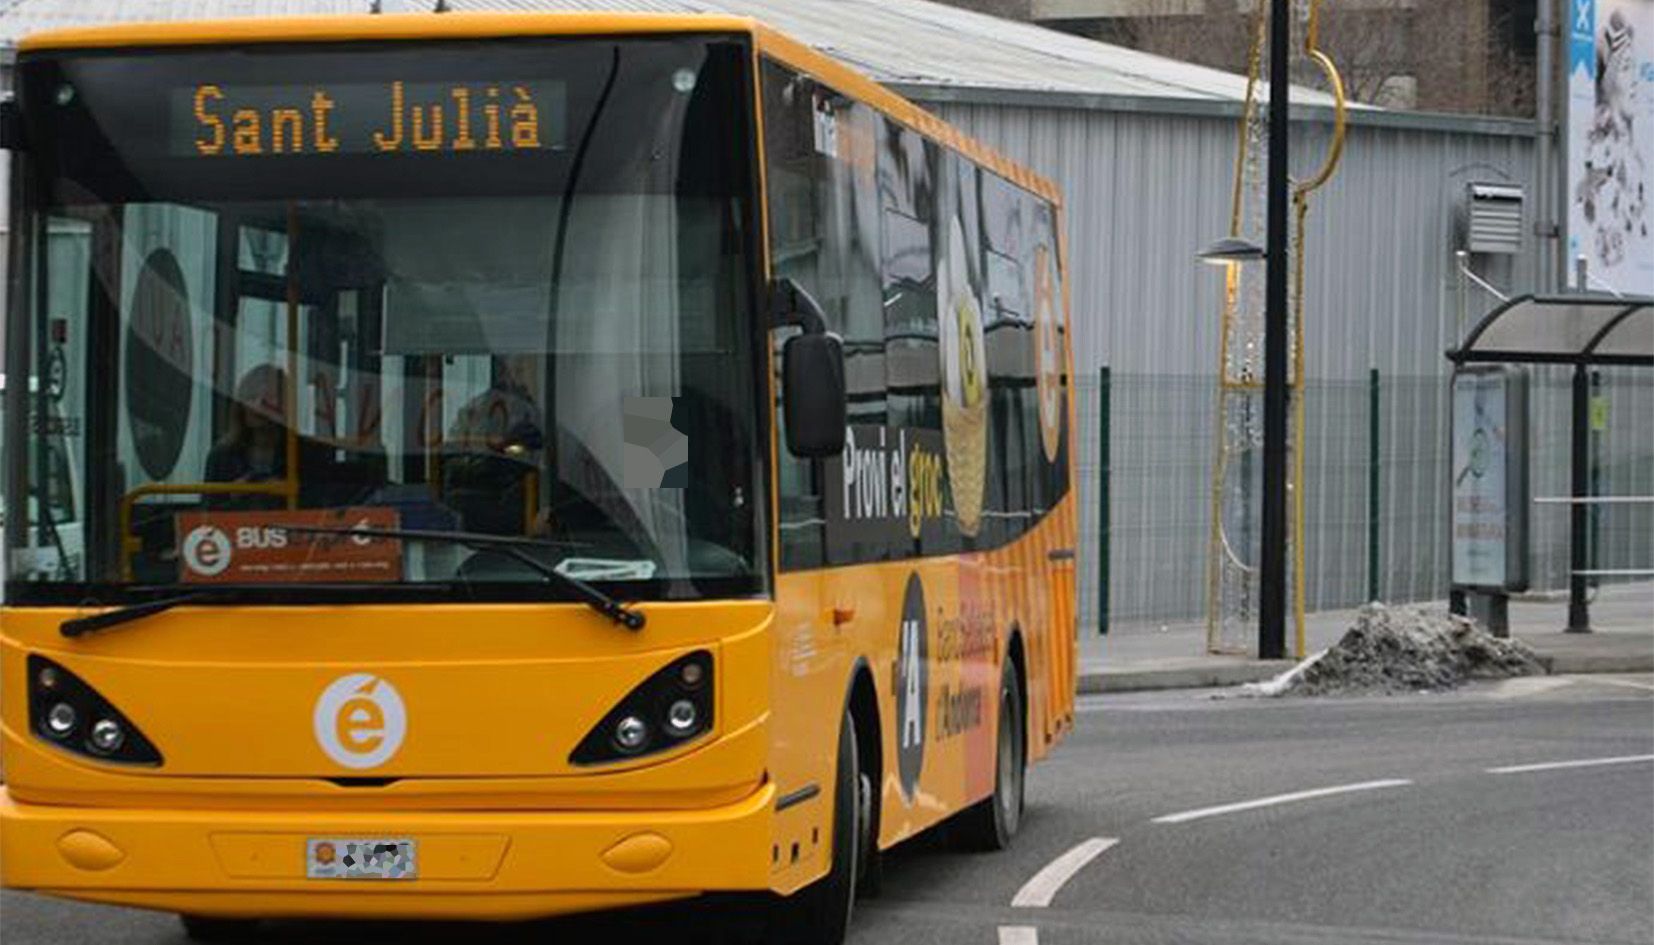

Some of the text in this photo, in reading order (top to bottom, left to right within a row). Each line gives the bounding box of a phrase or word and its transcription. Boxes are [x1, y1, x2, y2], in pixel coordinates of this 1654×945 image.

[194, 80, 541, 154] Sant Julià
[892, 429, 906, 517] el
[909, 442, 943, 538] groc
[236, 526, 288, 549] BUS
